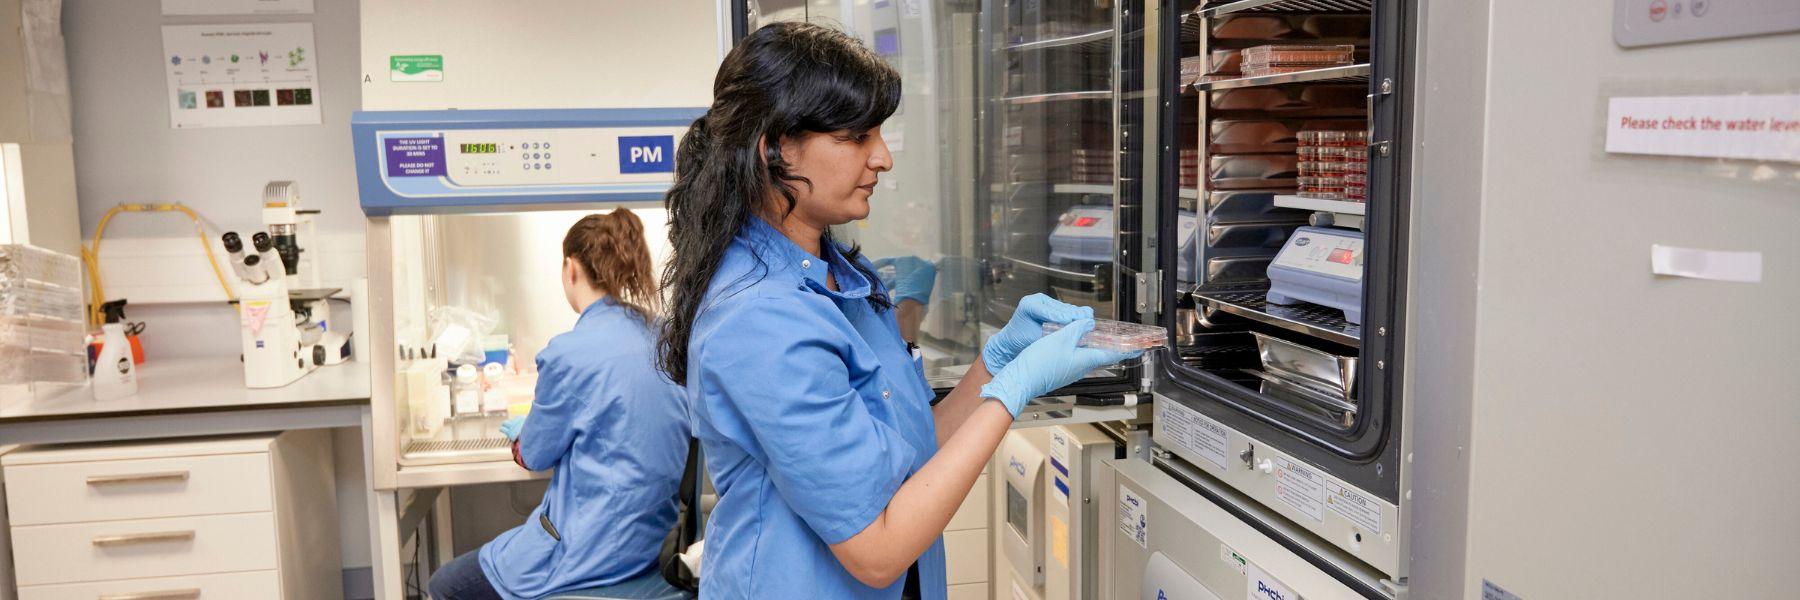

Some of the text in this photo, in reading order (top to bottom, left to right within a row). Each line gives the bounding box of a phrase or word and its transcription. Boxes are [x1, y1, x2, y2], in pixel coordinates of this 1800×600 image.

[364, 74, 372, 83] A
[1621, 116, 1658, 130] Please
[1662, 116, 1697, 130] check
[1701, 116, 1721, 131] the
[1726, 119, 1765, 131] water
[631, 146, 663, 163] PM
[1291, 465, 1313, 480] WARNING
[1344, 490, 1367, 507] CAUTION
